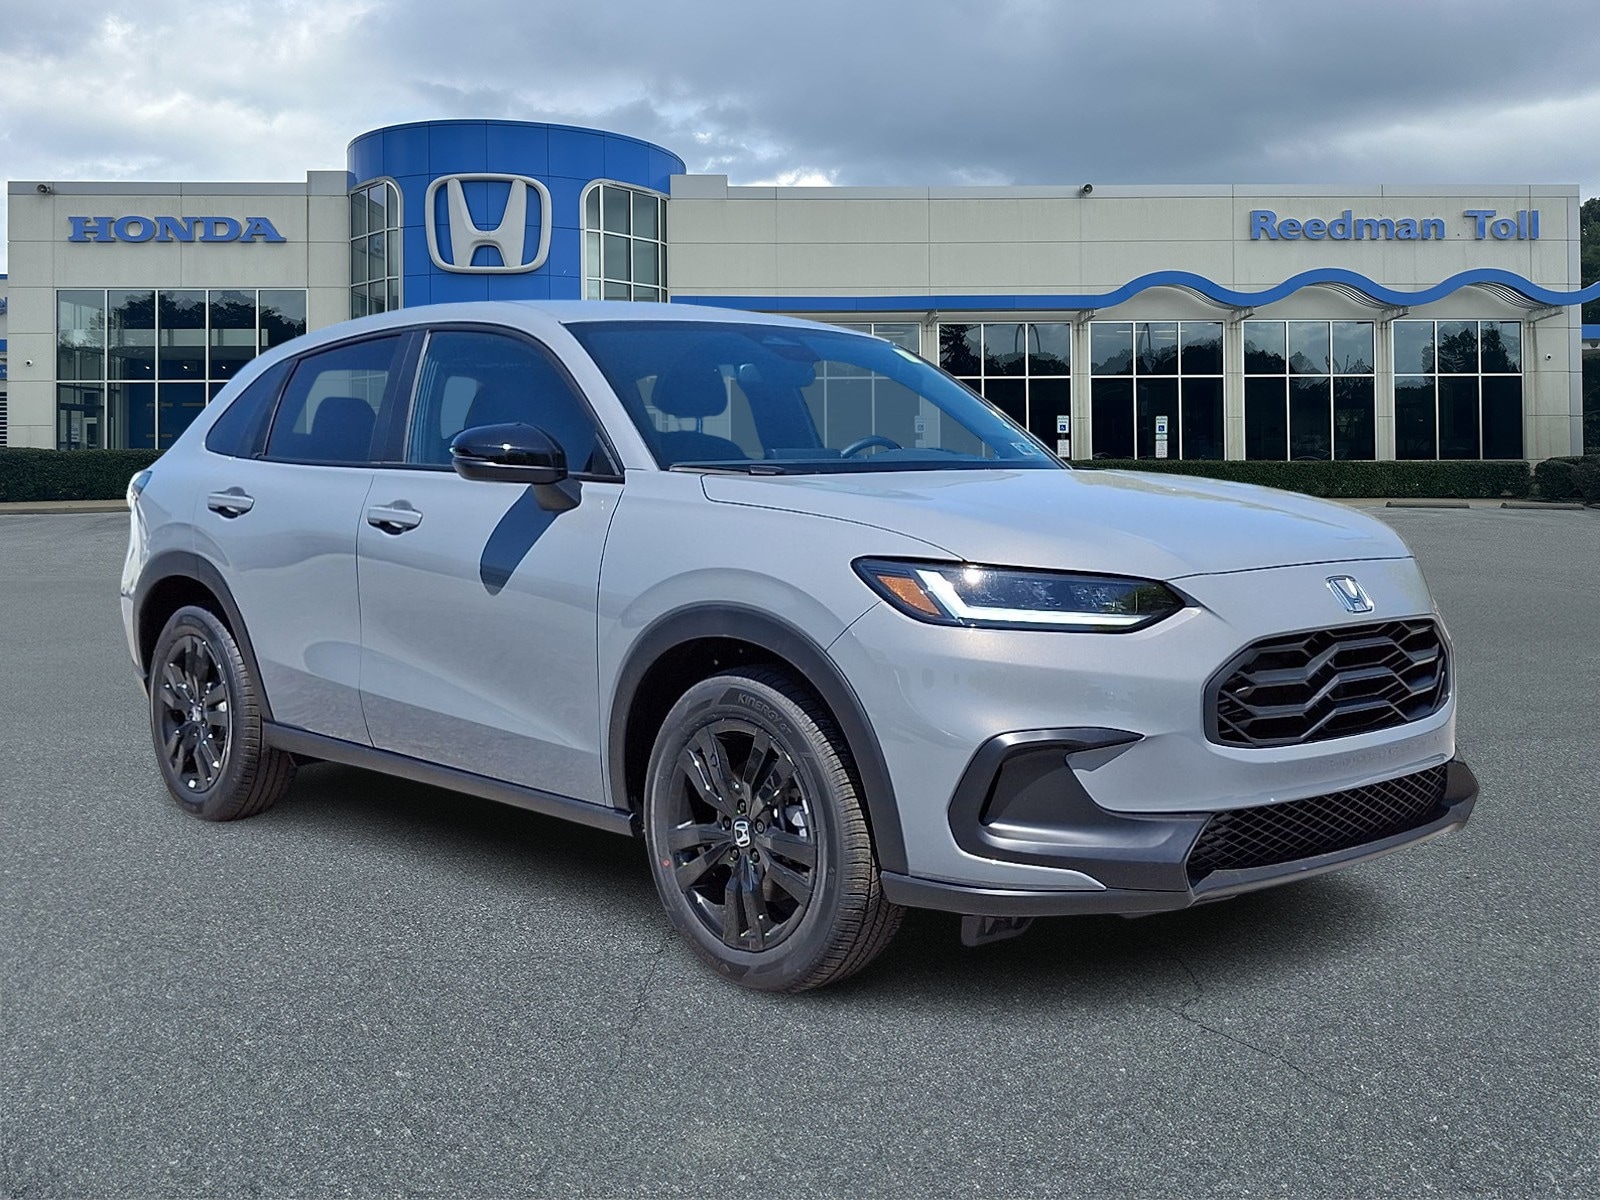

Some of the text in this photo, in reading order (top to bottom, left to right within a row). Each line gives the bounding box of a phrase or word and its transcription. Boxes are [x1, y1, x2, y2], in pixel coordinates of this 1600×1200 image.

[68, 215, 287, 243] HONDA
[1250, 209, 1540, 241] Reedman Toll
